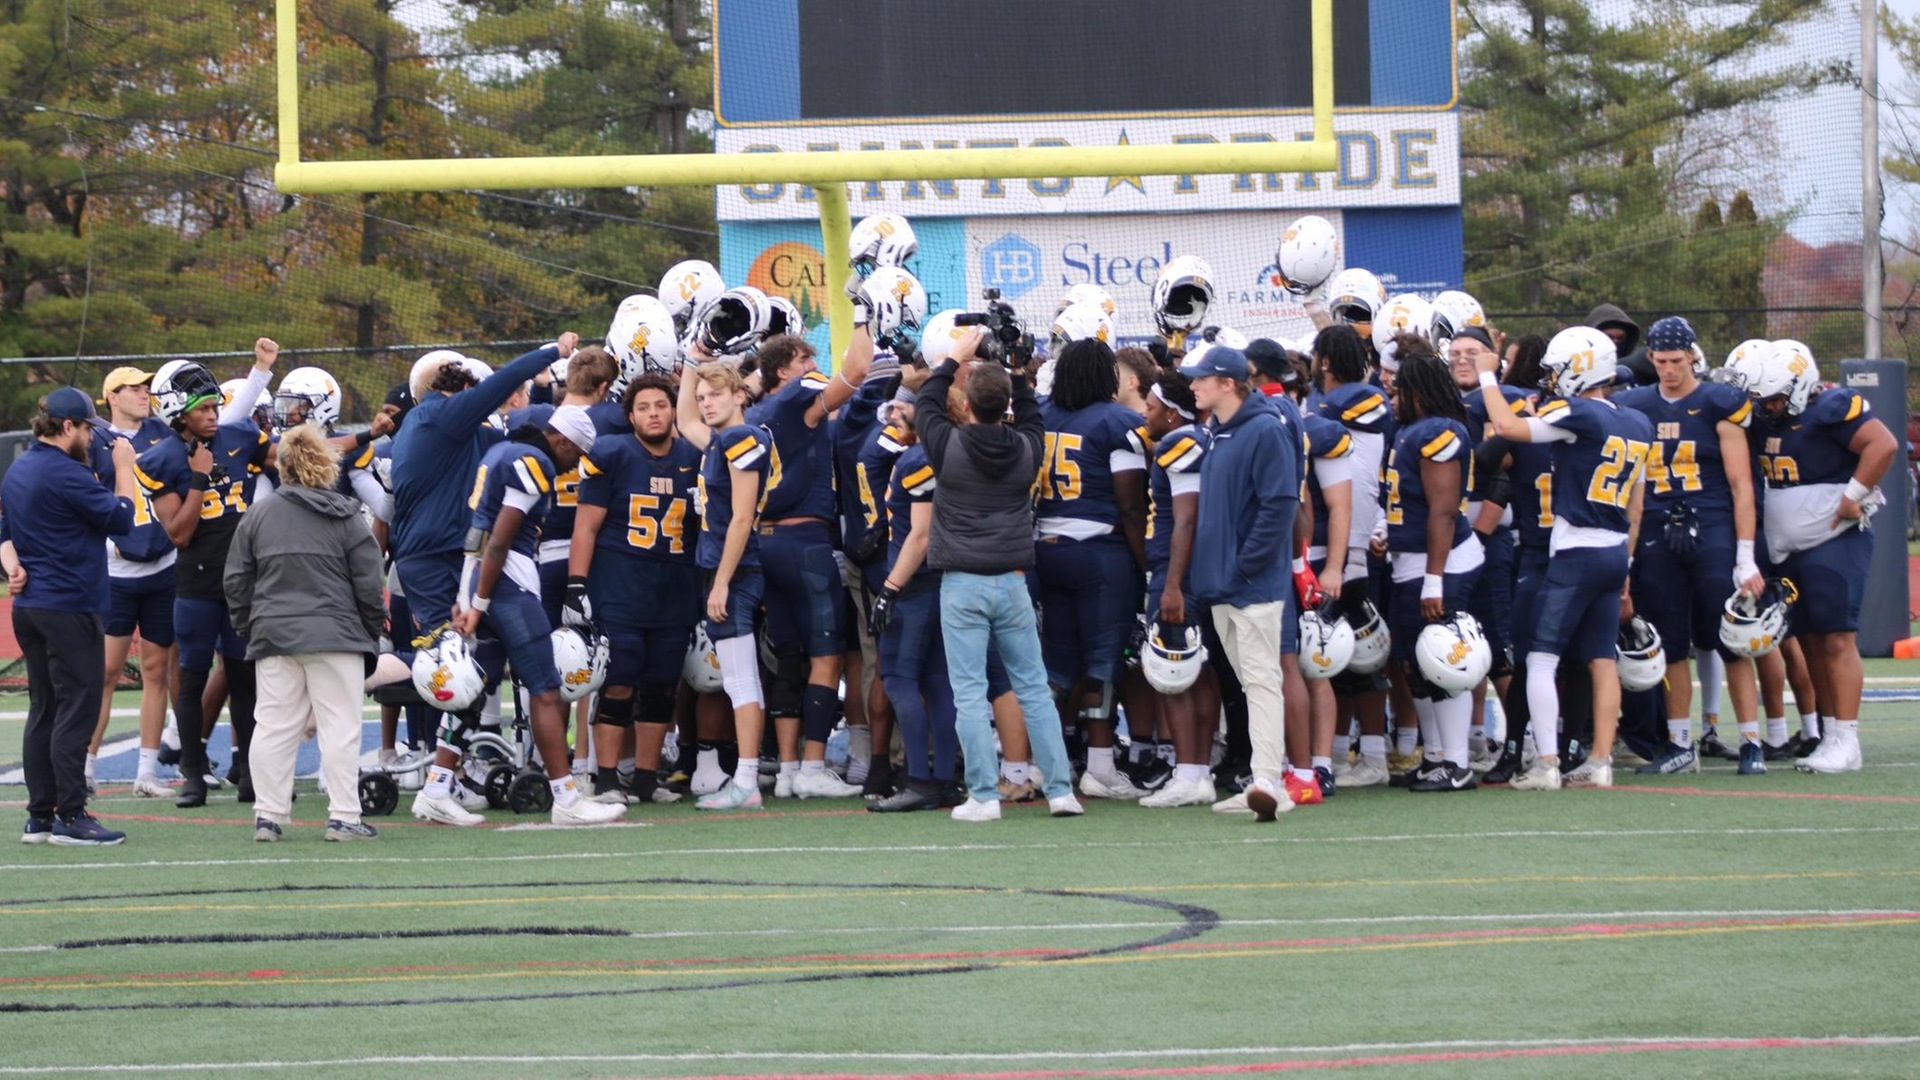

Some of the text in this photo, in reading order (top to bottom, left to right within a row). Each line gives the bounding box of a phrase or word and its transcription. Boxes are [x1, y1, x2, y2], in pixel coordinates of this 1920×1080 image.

[992, 249, 1034, 283] HB
[1227, 289, 1329, 304] FARMES
[1242, 305, 1307, 319] INSURANC
[1569, 350, 1594, 375] 27
[1657, 422, 1680, 439] SHU
[1586, 434, 1650, 509] 27
[1646, 440, 1702, 494] 44
[650, 476, 674, 494] SHU
[199, 480, 248, 520] 84
[626, 493, 687, 554] 54
